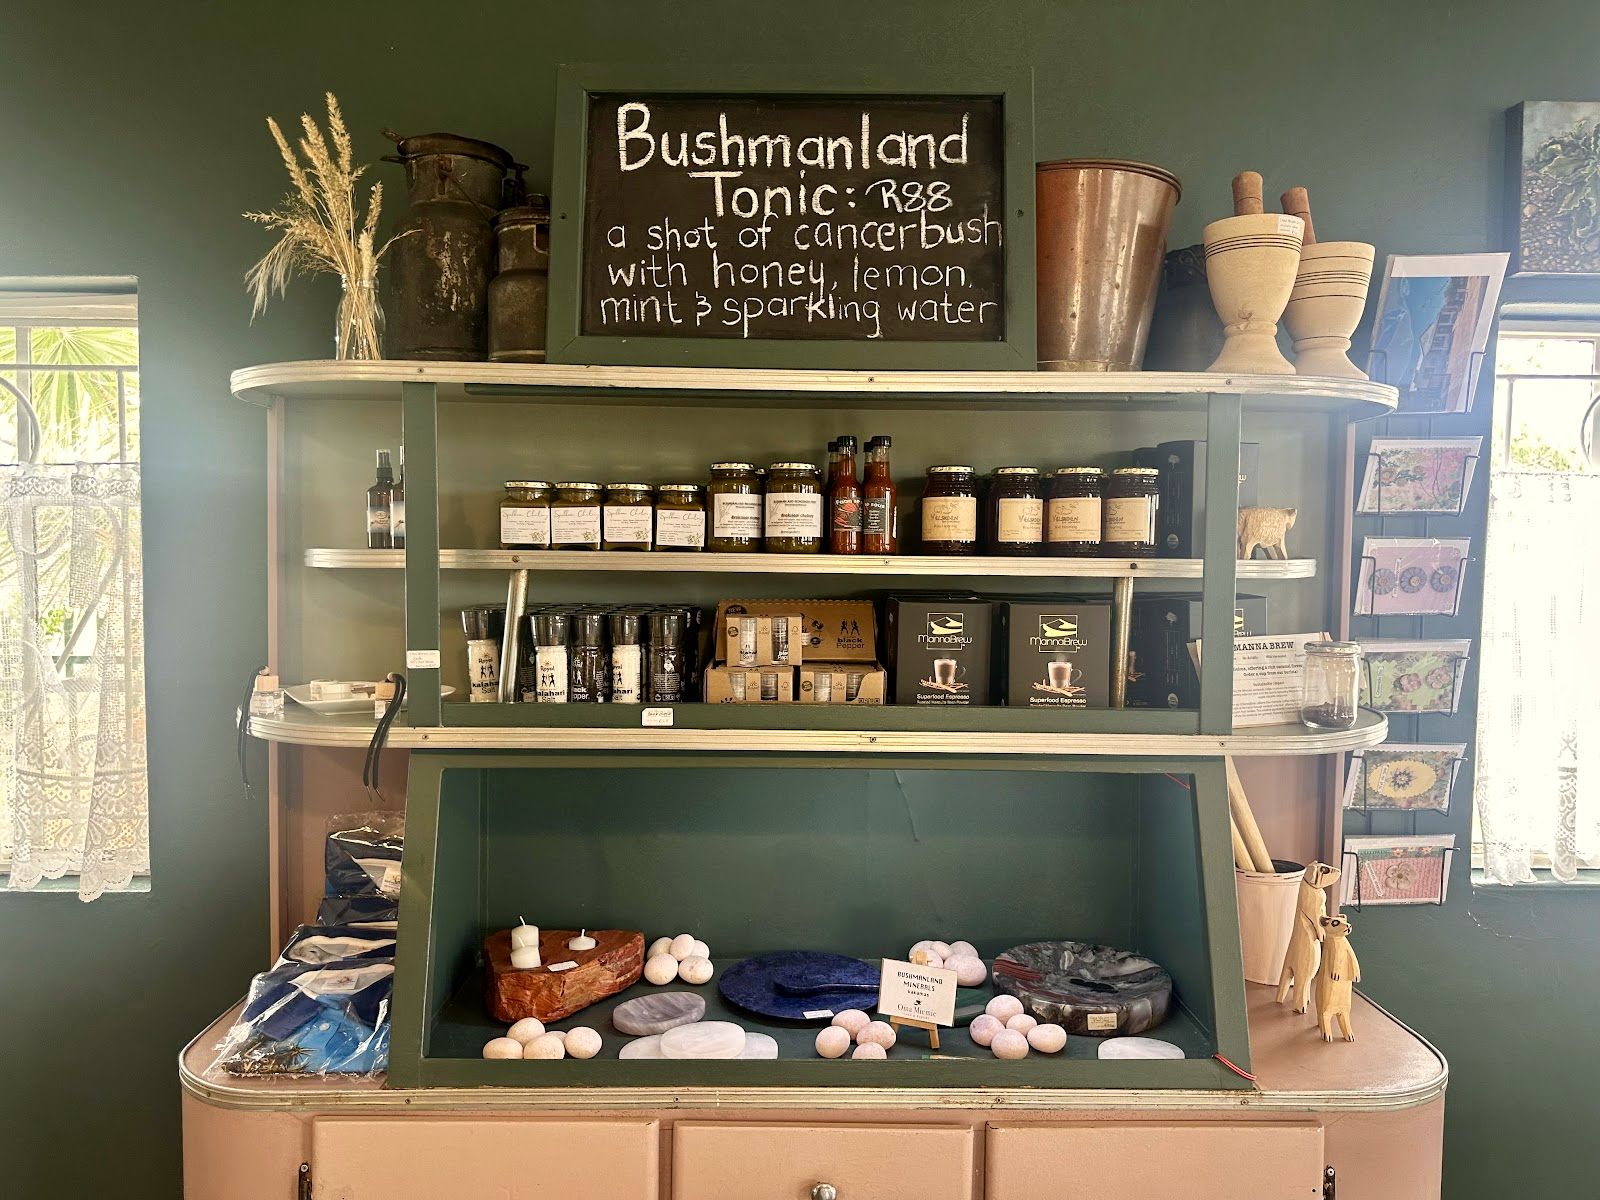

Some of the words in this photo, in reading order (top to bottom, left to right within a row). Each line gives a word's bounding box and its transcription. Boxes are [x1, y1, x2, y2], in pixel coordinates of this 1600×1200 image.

[616, 101, 970, 172] Bushmanland
[688, 170, 857, 218] Tonic:
[865, 178, 954, 213] R88
[606, 224, 626, 249] a
[647, 215, 718, 252] shot
[738, 211, 780, 251] of
[794, 201, 1003, 252] cancerbush
[607, 252, 688, 288] with
[712, 249, 838, 302] honey,
[600, 292, 683, 327] mint
[722, 291, 884, 339] sparkling
[897, 291, 999, 324] water
[918, 634, 972, 644] MannaBrew
[1030, 637, 1088, 646] MannaBrew
[1269, 641, 1294, 650] BREW
[897, 971, 943, 985] BUSHMANLAND
